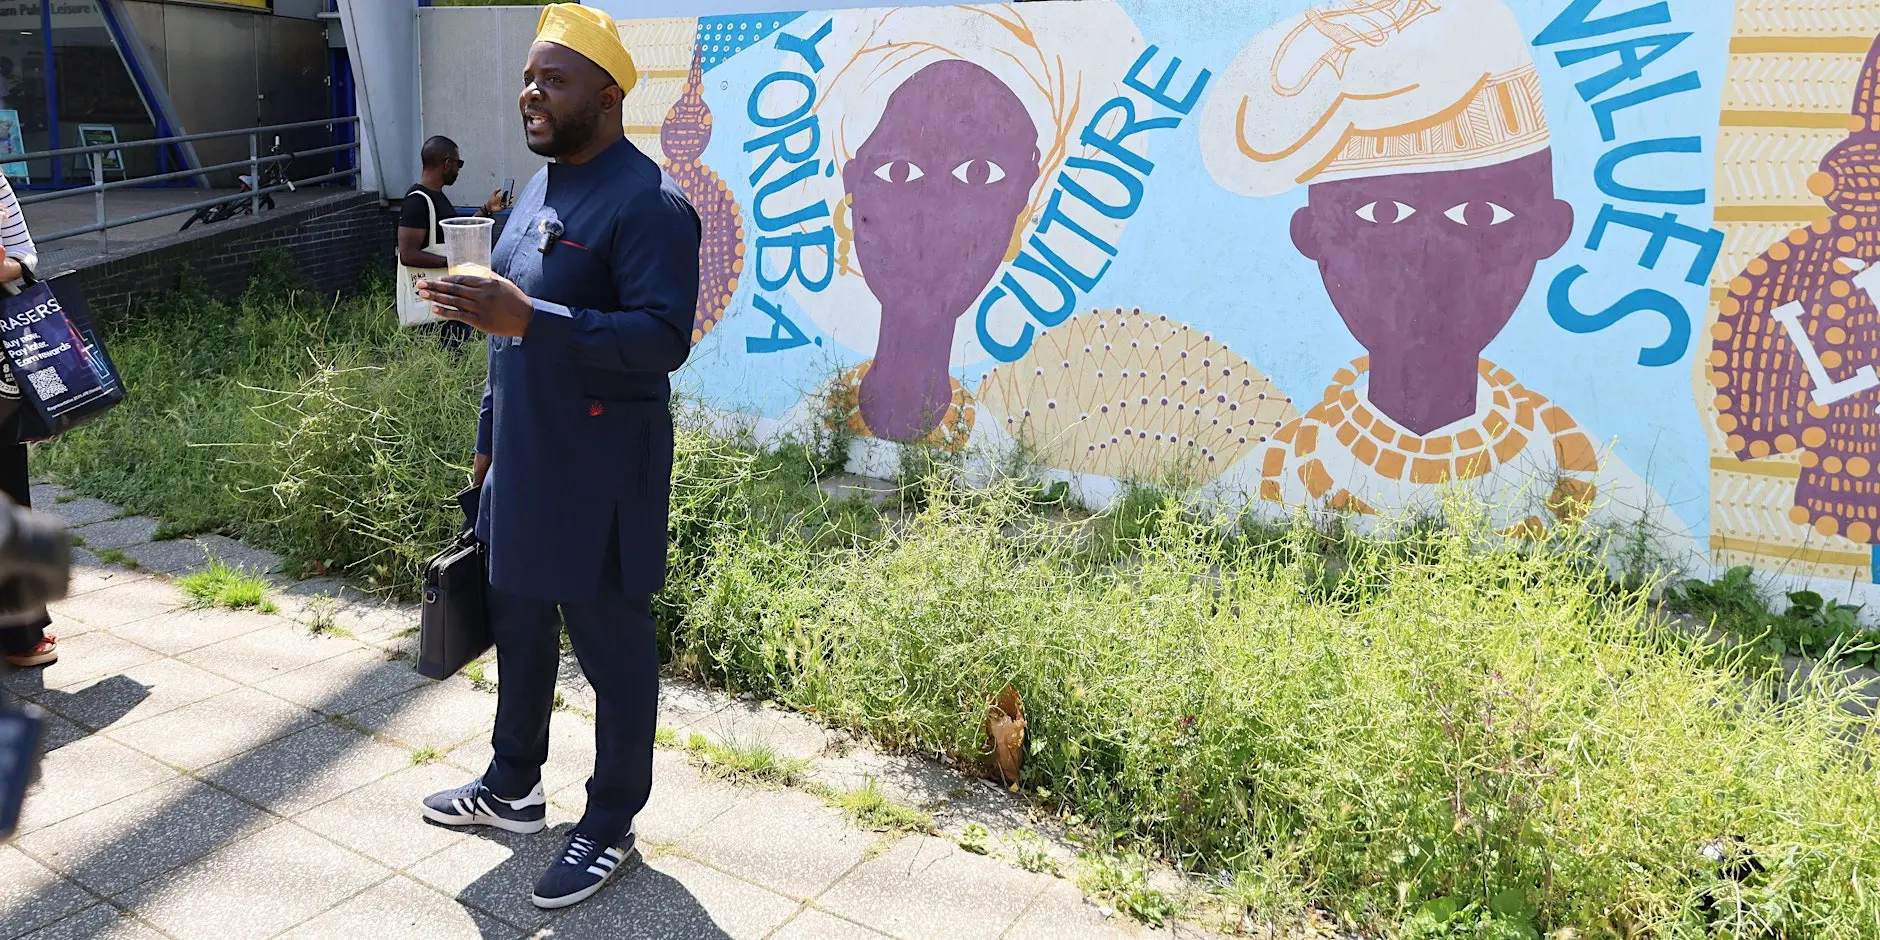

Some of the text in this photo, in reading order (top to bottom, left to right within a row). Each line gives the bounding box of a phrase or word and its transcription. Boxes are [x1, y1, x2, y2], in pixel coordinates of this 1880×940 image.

[1532, 0, 1725, 367] VALUES
[975, 44, 1212, 363] CULTURE
[0, 298, 62, 333] RASERS
[3, 332, 41, 348] Buy now.
[8, 347, 28, 358] Pay
[25, 341, 49, 351] later.
[15, 342, 71, 367] Earn rewards
